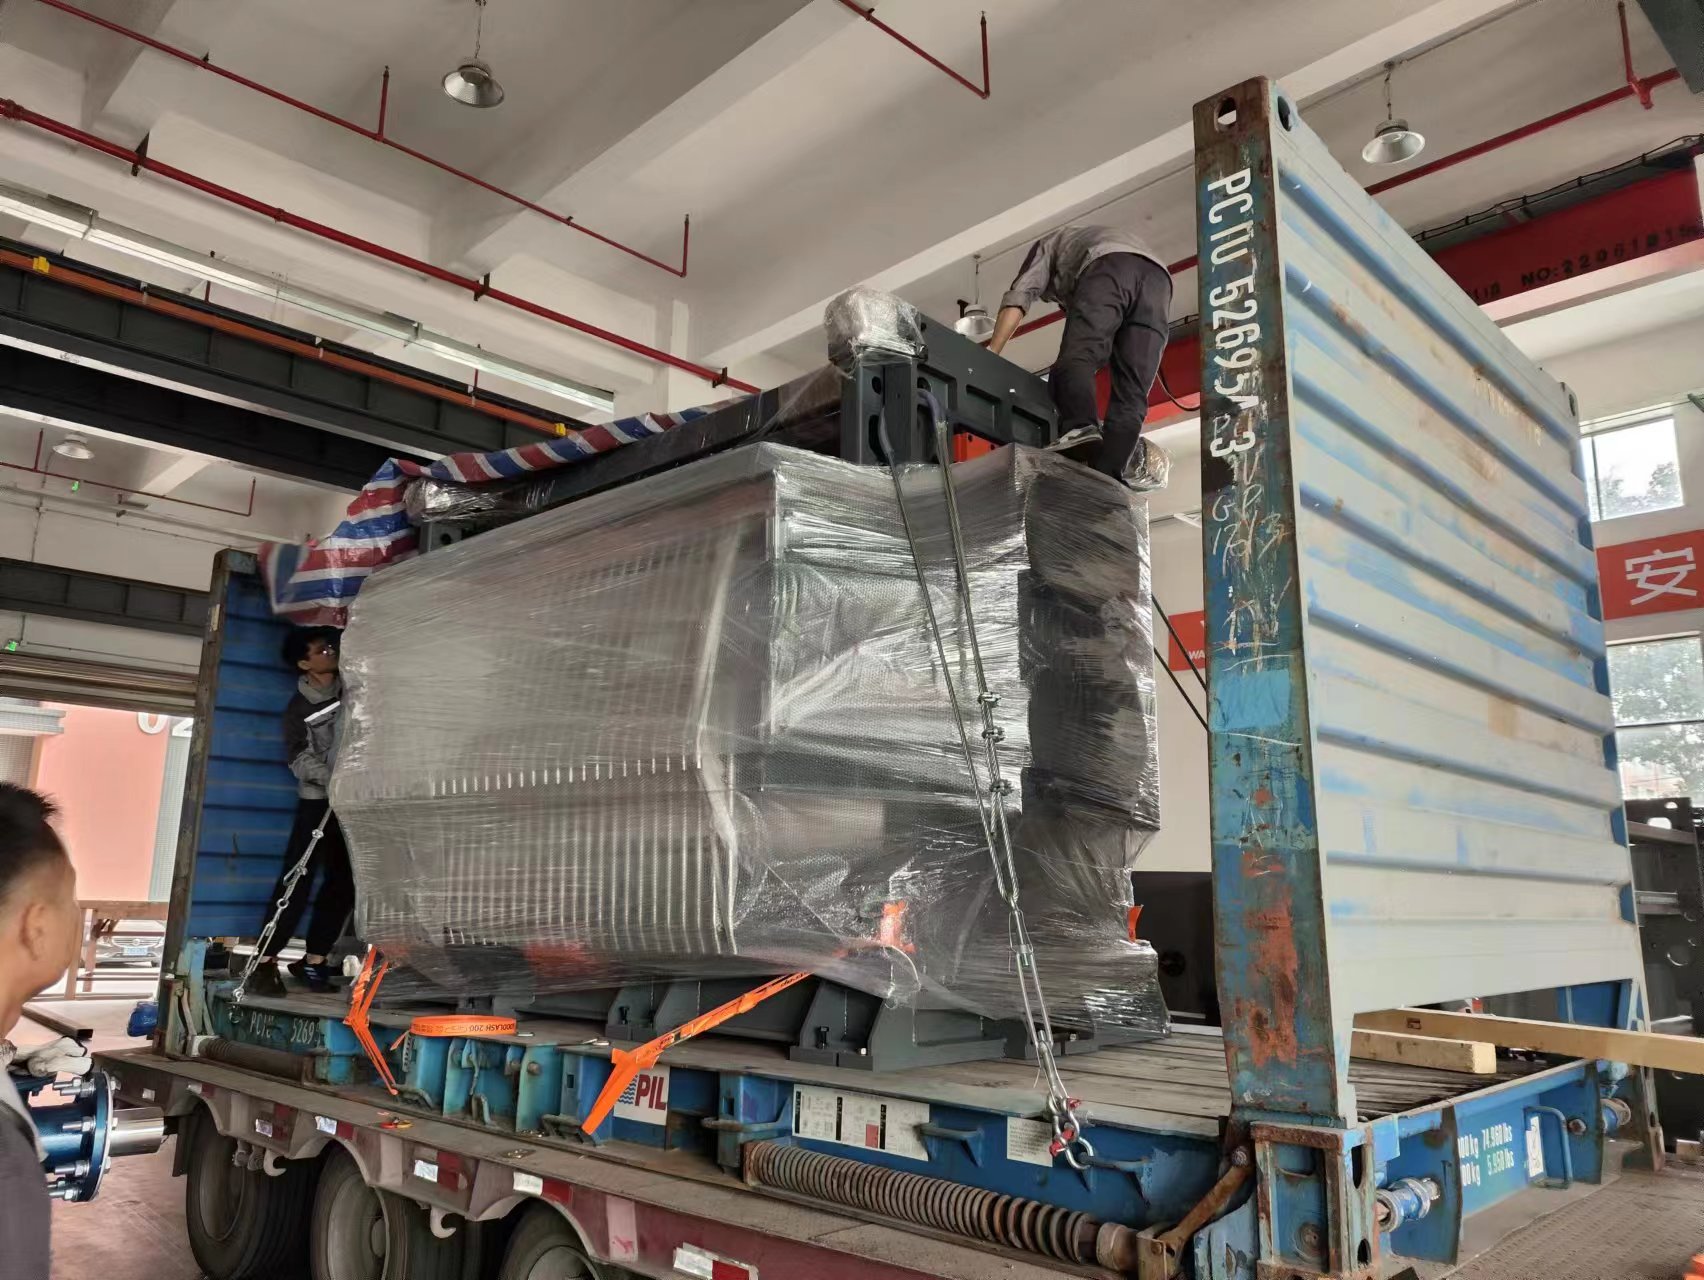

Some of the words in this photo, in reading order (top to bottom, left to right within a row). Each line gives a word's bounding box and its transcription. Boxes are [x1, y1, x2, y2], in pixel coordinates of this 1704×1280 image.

[1210, 431, 1256, 457] 3
[1625, 547, 1698, 606] 安
[635, 1073, 667, 1111] PIL
